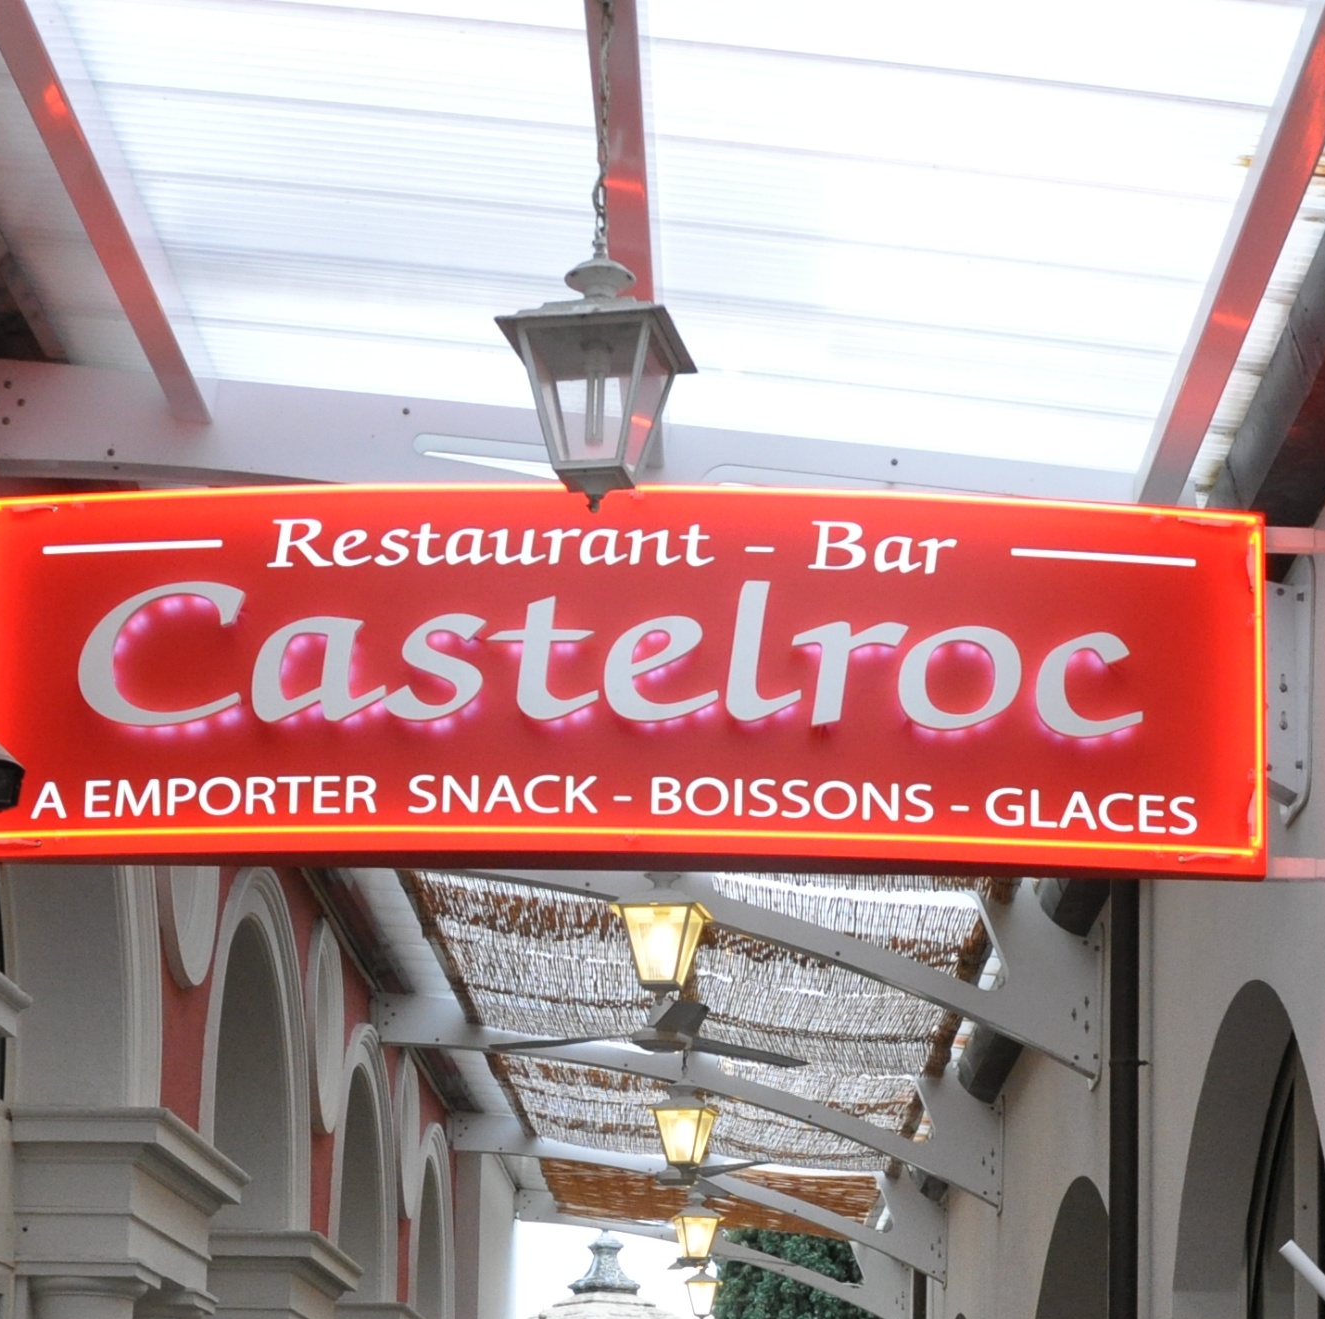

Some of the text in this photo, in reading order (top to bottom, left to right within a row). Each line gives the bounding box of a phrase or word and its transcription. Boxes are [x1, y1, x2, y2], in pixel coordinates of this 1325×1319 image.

[266, 517, 716, 569] Restaurant
[806, 519, 959, 576] Bar
[76, 580, 1144, 738] Castelroc
[30, 781, 68, 820] A
[83, 775, 378, 819] EMPORTER
[407, 773, 599, 815] SNACK
[650, 775, 935, 824] BOISSONS
[984, 787, 1198, 836] GLACES
